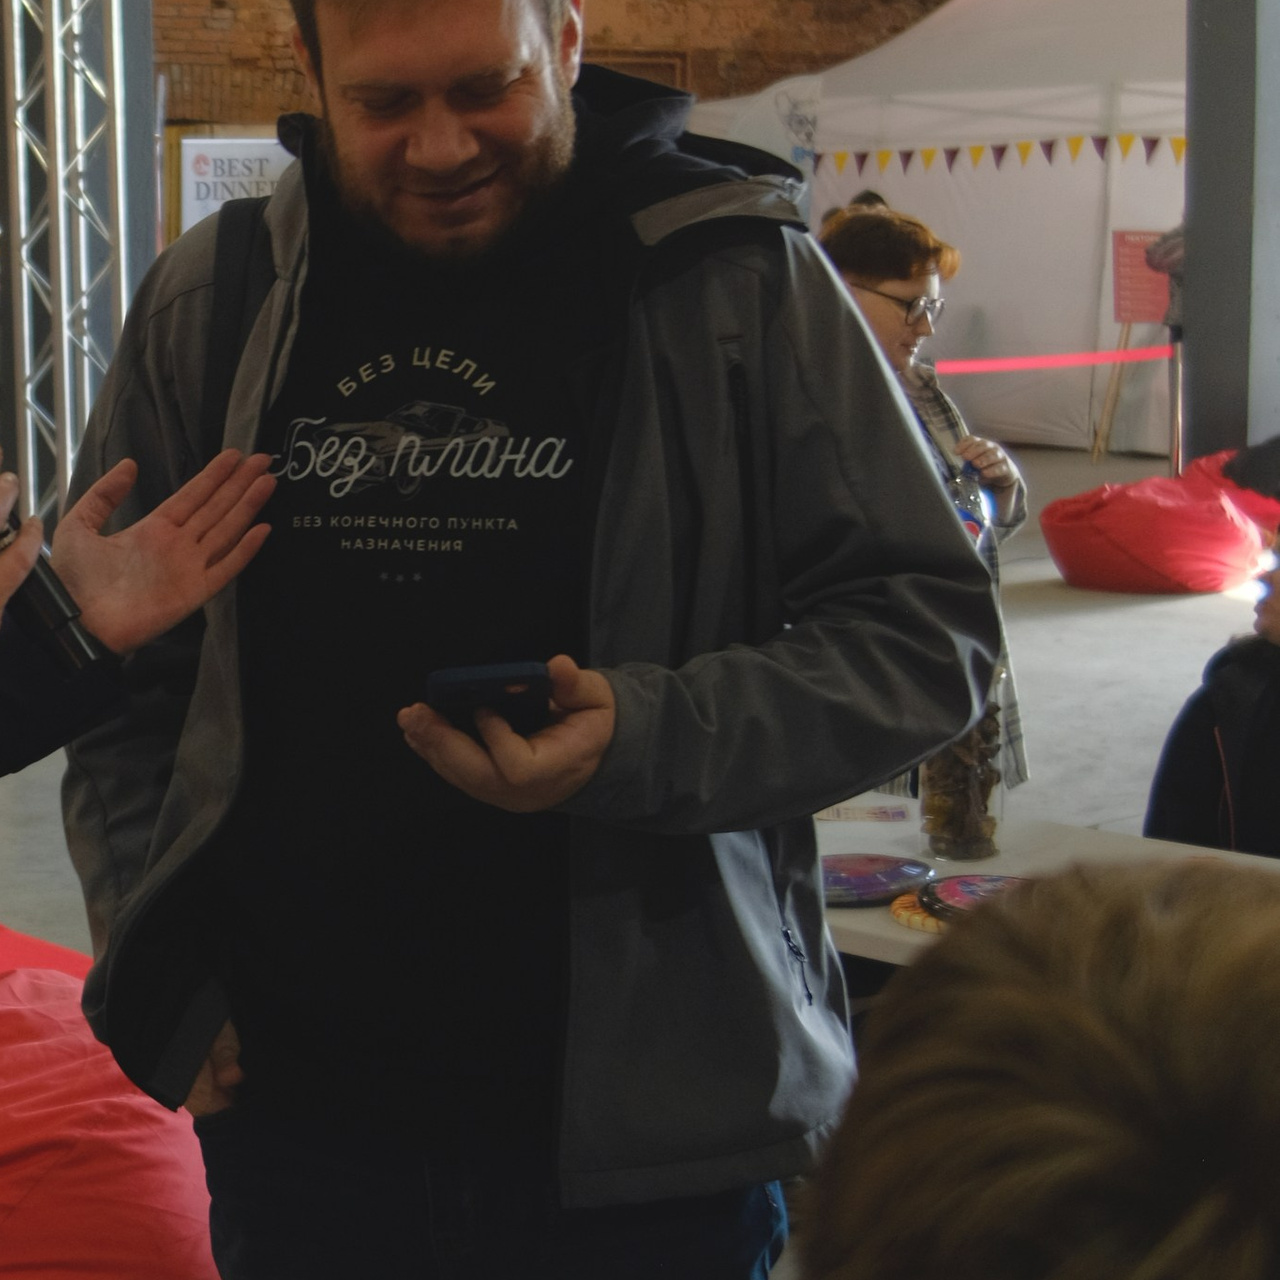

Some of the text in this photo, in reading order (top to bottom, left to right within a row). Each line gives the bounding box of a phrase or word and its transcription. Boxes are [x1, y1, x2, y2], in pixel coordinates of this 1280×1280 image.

[212, 158, 269, 178] BEST
[336, 347, 497, 397] БЕЗ ЦЕЛИ
[271, 417, 574, 498] Без плана
[292, 515, 518, 531] БЕЗ КОНЕЧНОГО ПУНКТА
[340, 538, 463, 552] НАЗНАЧЕНИЯ
